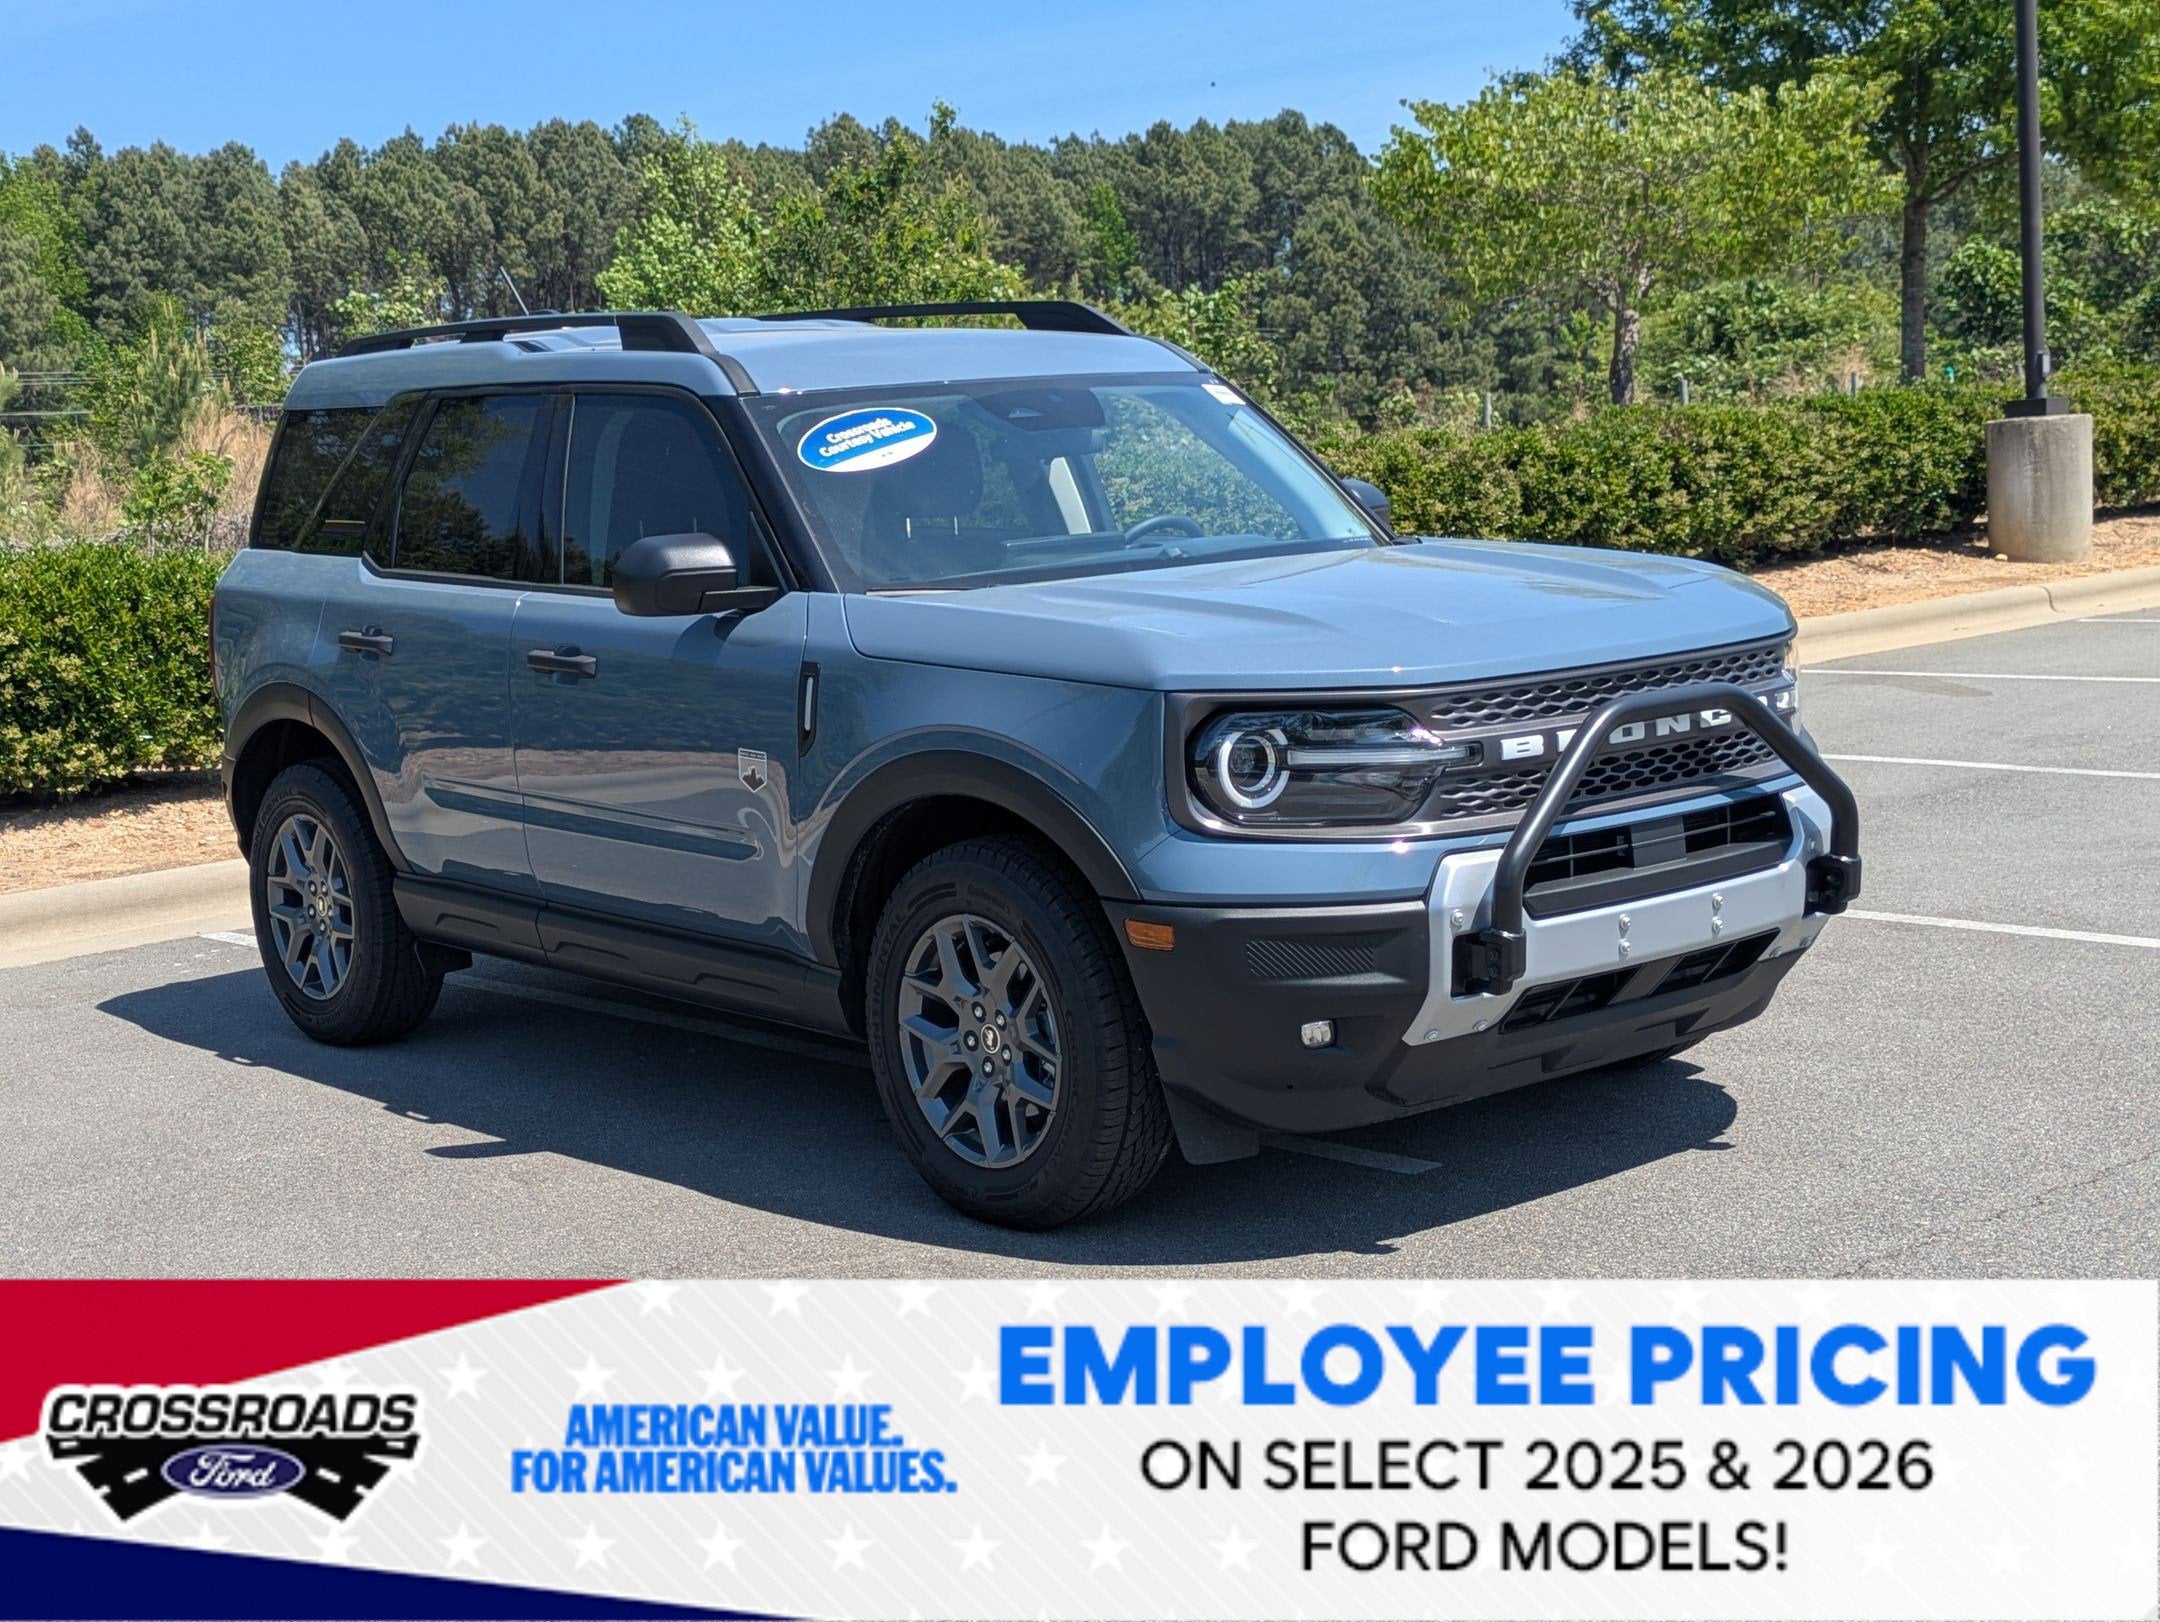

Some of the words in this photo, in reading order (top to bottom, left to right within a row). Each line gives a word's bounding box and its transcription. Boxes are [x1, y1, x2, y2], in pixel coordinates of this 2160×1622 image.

[818, 433, 875, 457] Courtesy
[866, 421, 917, 440] Vehicle
[825, 417, 893, 443] Crossroads
[1500, 695, 1768, 761] BONC
